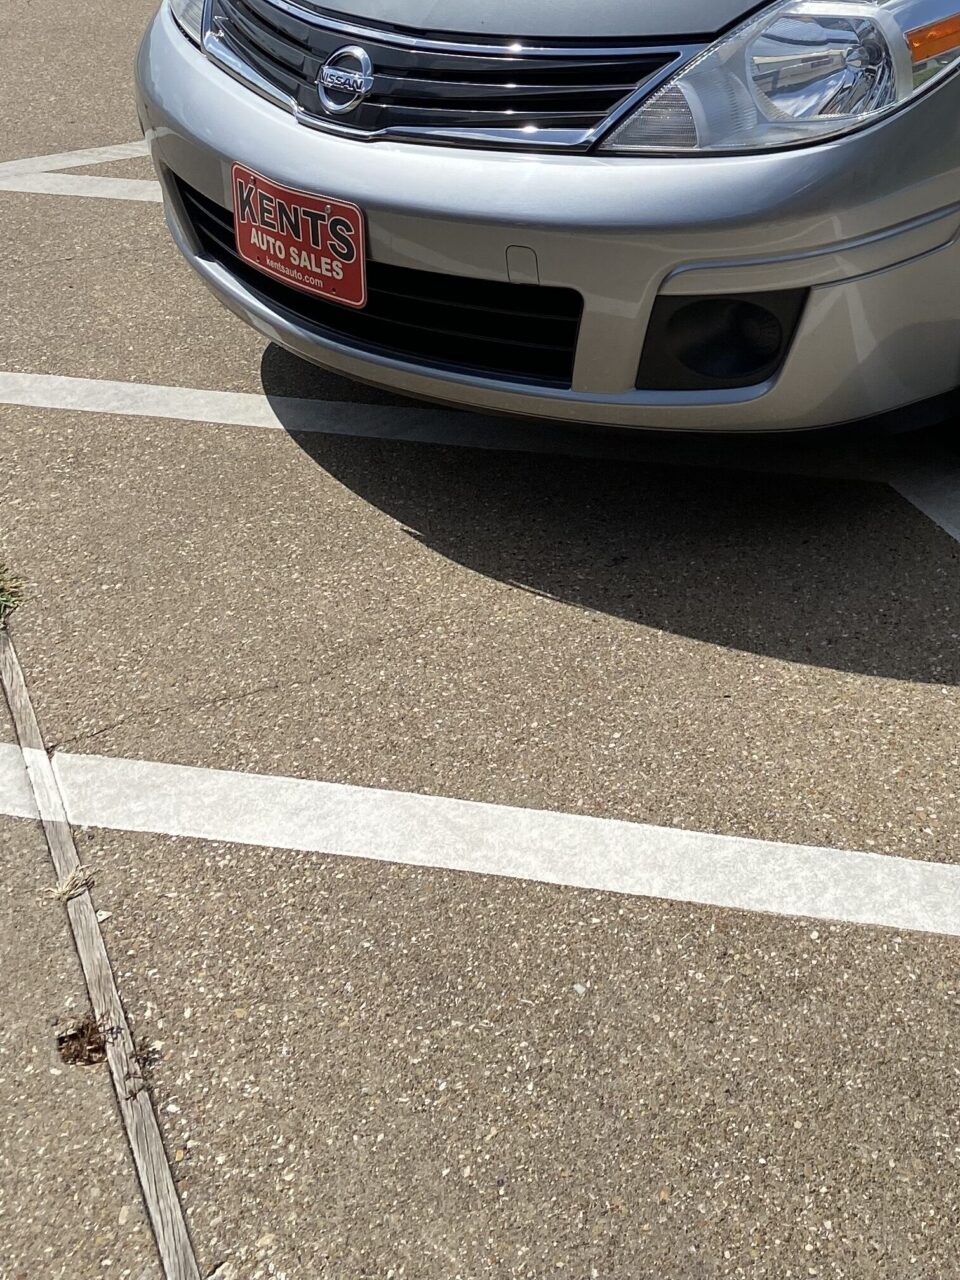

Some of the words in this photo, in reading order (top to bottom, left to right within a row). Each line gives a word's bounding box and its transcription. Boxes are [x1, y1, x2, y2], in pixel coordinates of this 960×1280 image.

[319, 68, 364, 91] NISSAN
[250, 227, 286, 259] AUTO
[290, 247, 344, 280] SALES
[266, 255, 324, 288] kentsauto.com
